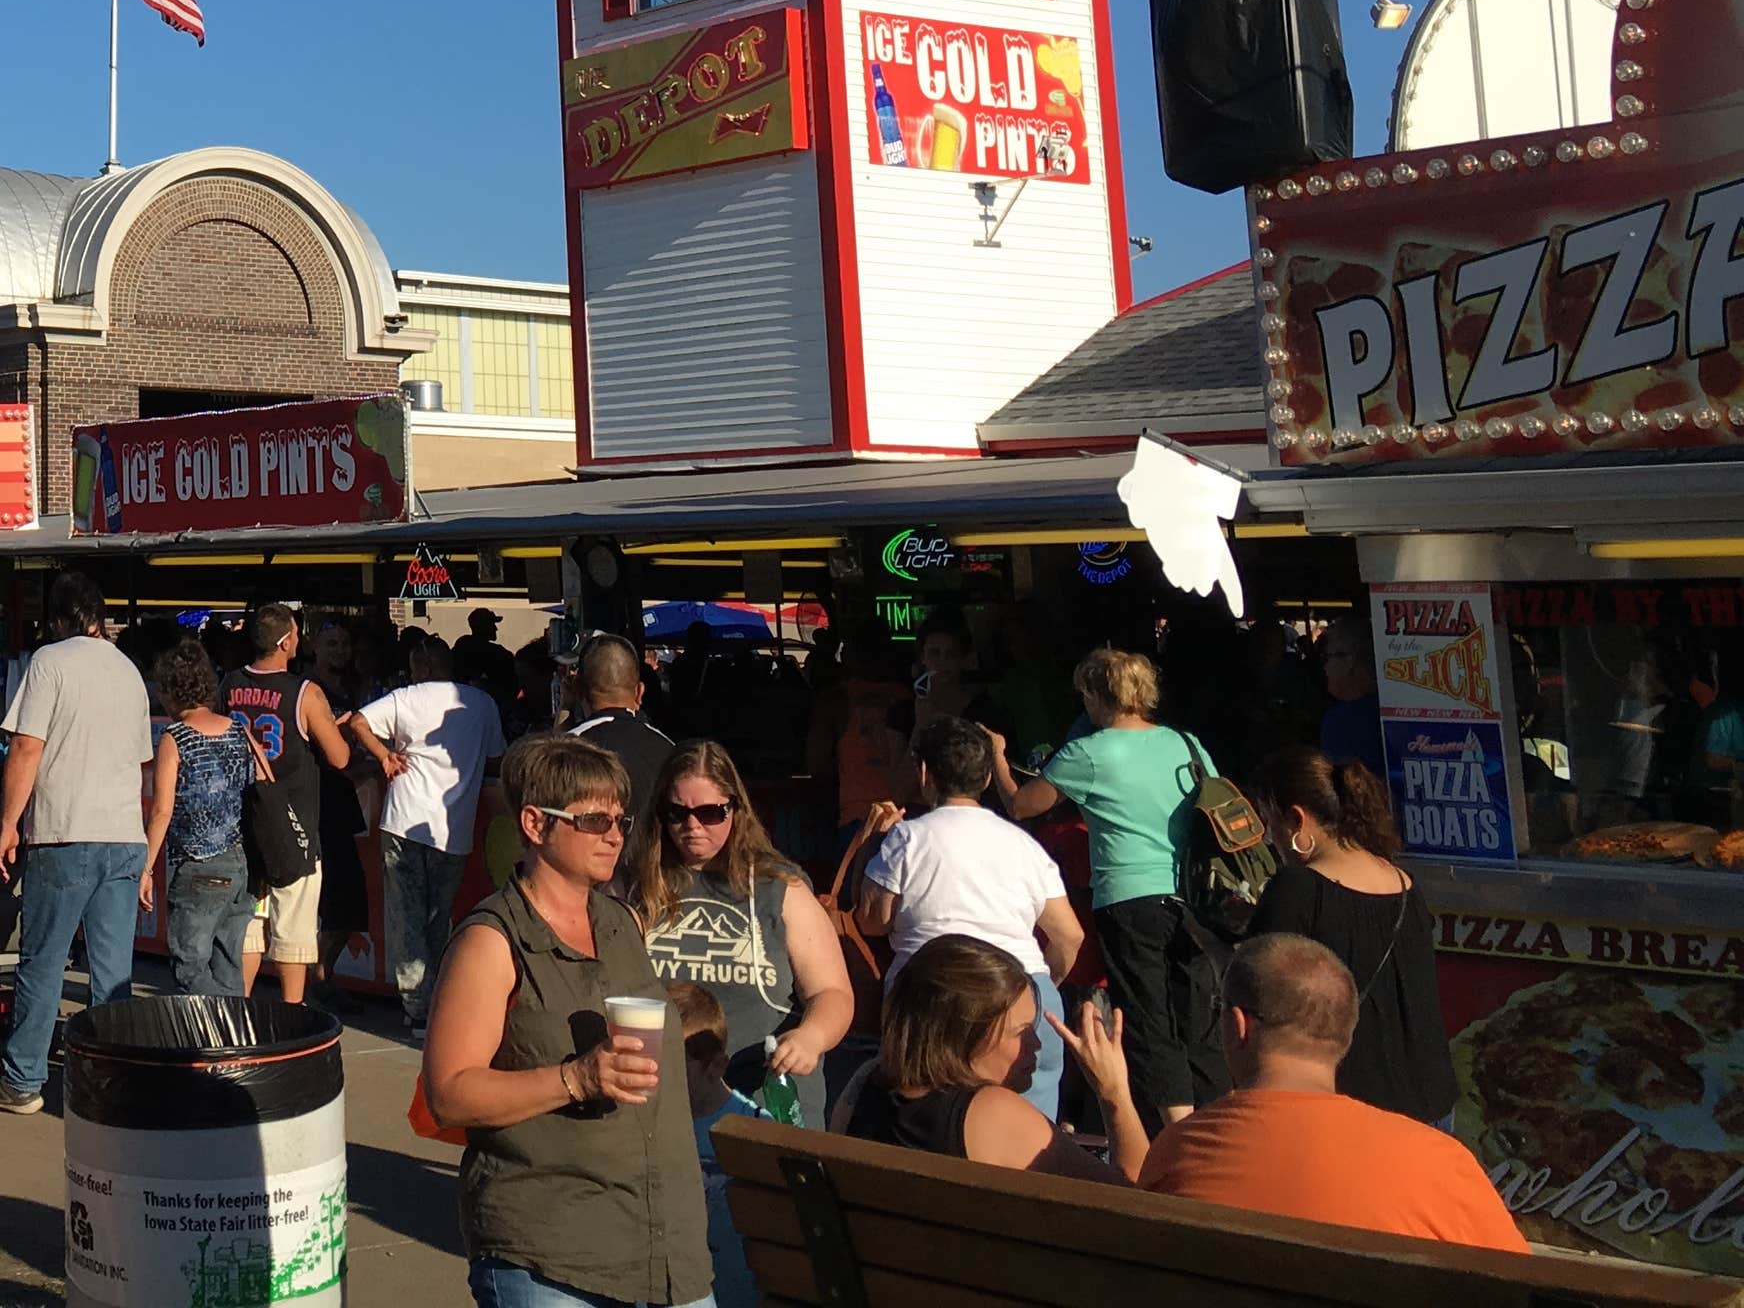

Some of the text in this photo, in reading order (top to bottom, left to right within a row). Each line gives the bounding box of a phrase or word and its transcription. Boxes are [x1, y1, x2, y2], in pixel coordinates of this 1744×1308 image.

[865, 14, 1038, 112] ICE COLD
[576, 24, 767, 169] DEPOT
[974, 112, 1076, 178] PINTS
[122, 423, 357, 506] ICE COLD PINTS
[894, 553, 955, 569] LIGHT
[903, 537, 948, 553] BUD
[407, 559, 450, 585] Coors
[413, 583, 441, 597] LIGHT
[1384, 599, 1480, 637] PIZZA
[1492, 585, 1744, 630] PIZZA BY TH
[1402, 637, 1423, 652] the
[1383, 623, 1495, 718] SLICE
[227, 686, 282, 709] JORDAN
[1403, 758, 1491, 804] PIZZA
[1404, 803, 1500, 850] BOATS
[1434, 912, 1569, 959] IZZA
[687, 961, 778, 988] TRUCKS
[143, 1189, 294, 1213] Thanks for keeping the
[144, 1206, 310, 1233] Iowa State Fair litter-free!
[109, 1265, 129, 1283] INC.
